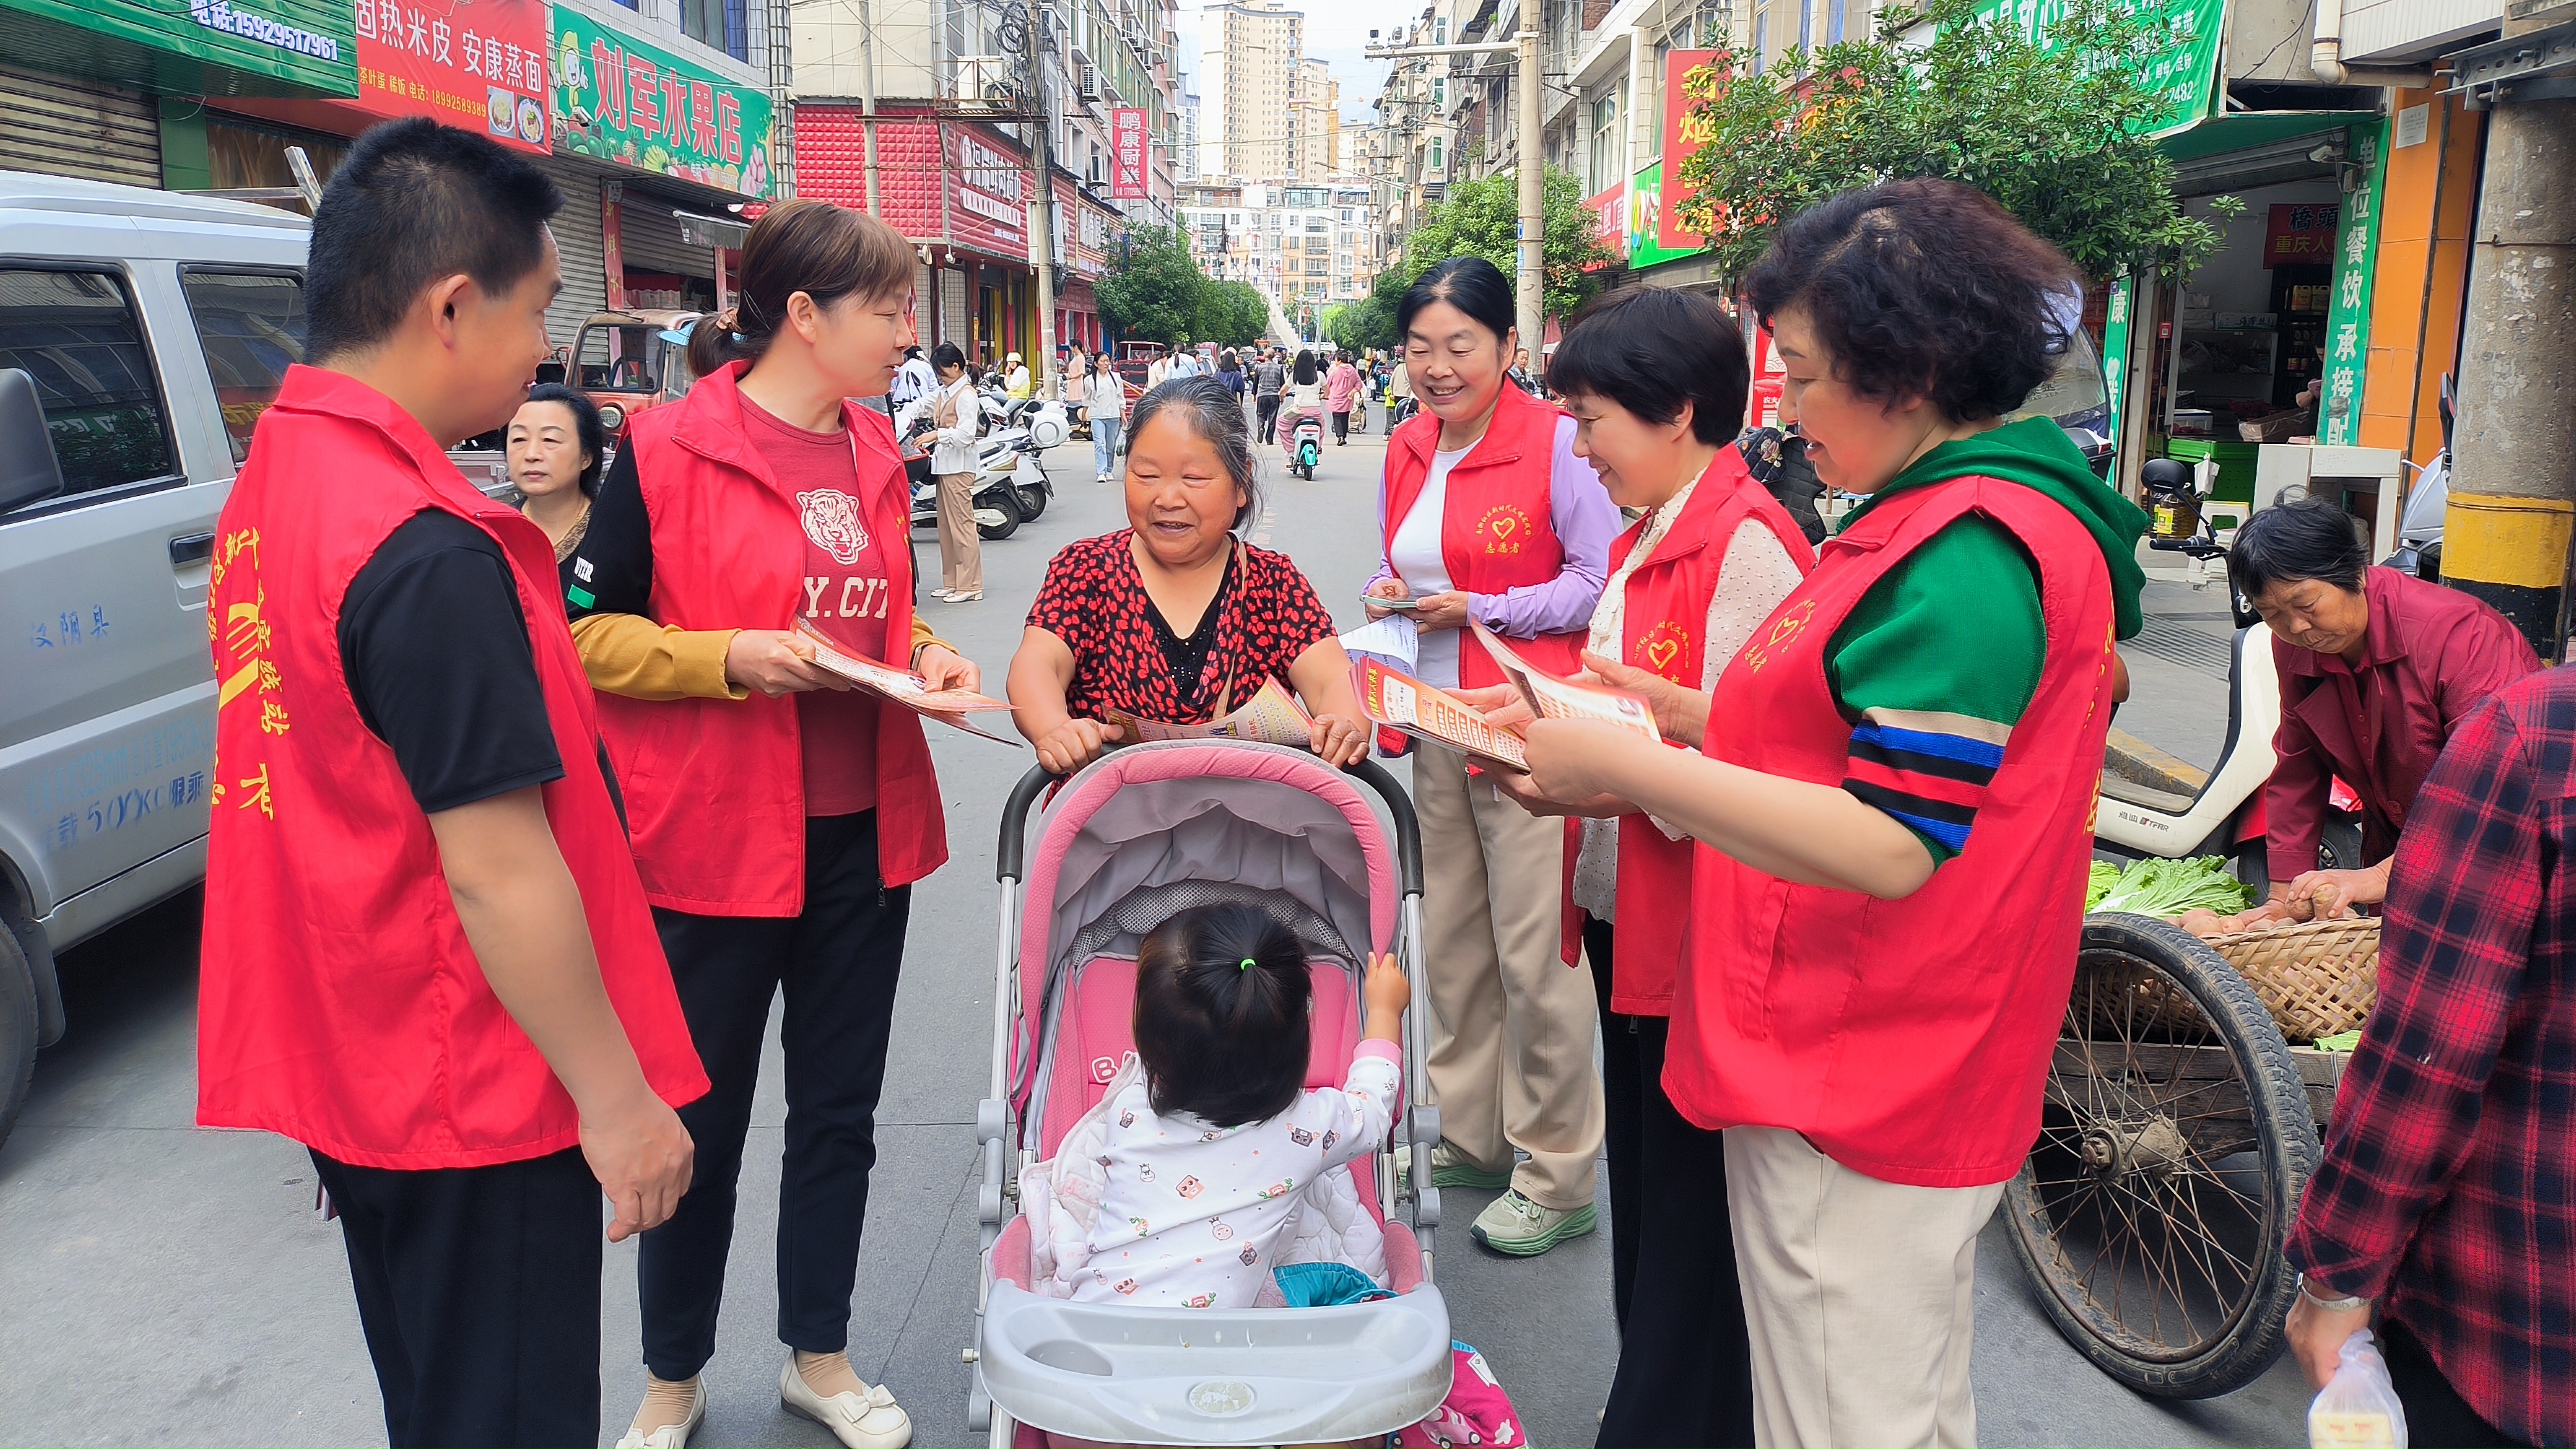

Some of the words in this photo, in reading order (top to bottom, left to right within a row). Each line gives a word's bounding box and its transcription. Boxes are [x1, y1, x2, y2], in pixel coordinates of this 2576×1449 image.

[462, 28, 542, 93] 安康蒸面
[359, 66, 386, 90] 茶叶蛋
[389, 75, 406, 96] 稀饭
[432, 89, 486, 118] 18992589389
[591, 38, 743, 164] 刘军水果店
[2273, 234, 2337, 254] 重庆人
[1485, 540, 1520, 554] 志愿者
